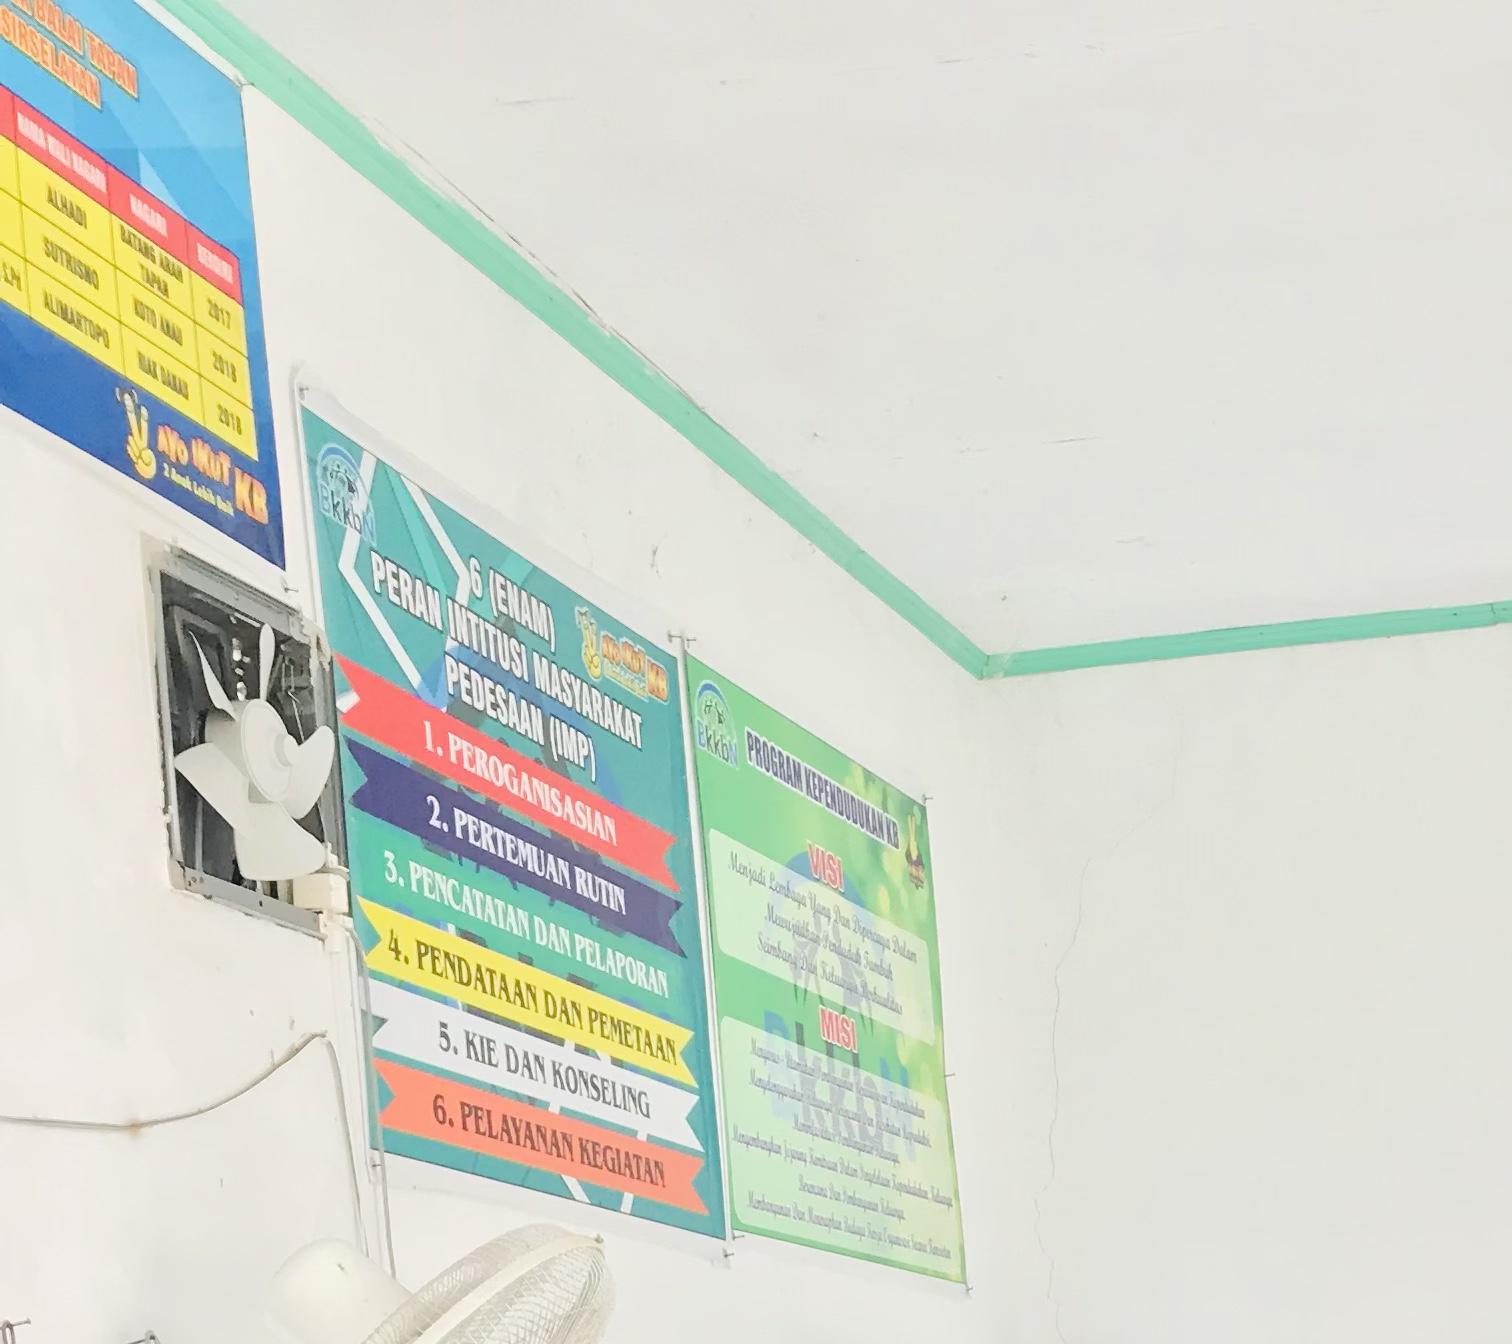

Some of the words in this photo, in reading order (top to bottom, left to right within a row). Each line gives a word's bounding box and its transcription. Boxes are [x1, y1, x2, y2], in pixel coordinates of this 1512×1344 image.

[46, 185, 87, 229] ALHADI
[207, 298, 231, 330] 2017
[212, 350, 237, 383] 2018
[217, 403, 242, 435] 2018
[234, 466, 269, 525] KB
[370, 550, 444, 631] PERAN
[446, 597, 529, 682] INTITUSI
[532, 652, 643, 750] MASYARAKAT
[468, 556, 483, 599] 6
[488, 567, 556, 652] (ENAM)
[444, 652, 545, 745] PEDESAAN
[549, 714, 596, 782] (IMP)
[424, 721, 443, 757] 1.
[448, 732, 618, 847] PEROGANISASIAN
[746, 730, 803, 793] PROGRAM
[804, 765, 885, 842] KEPENDUDUKAN
[427, 795, 449, 833] 2.
[453, 806, 571, 890] PERTEMUAN
[575, 867, 627, 916] RUTIN
[807, 840, 844, 893] VISI
[383, 850, 405, 888] 3.
[409, 860, 530, 941] PENCATATAN
[534, 916, 570, 956] DAN
[574, 932, 669, 999] PELAPORAN
[387, 928, 409, 966] 4.
[416, 939, 539, 1014] PENDATAAN
[544, 991, 582, 1028] DAN
[588, 1008, 677, 1066] PEMETAAN
[818, 1005, 858, 1053] MISI
[438, 1021, 458, 1056] 5.
[464, 1029, 498, 1059] KIE
[505, 1042, 547, 1081] DAN
[552, 1059, 651, 1119] KONSELING
[432, 1093, 455, 1128] 6.
[460, 1101, 575, 1162] PELAYANAN
[579, 1137, 667, 1189] KEGIATAN
